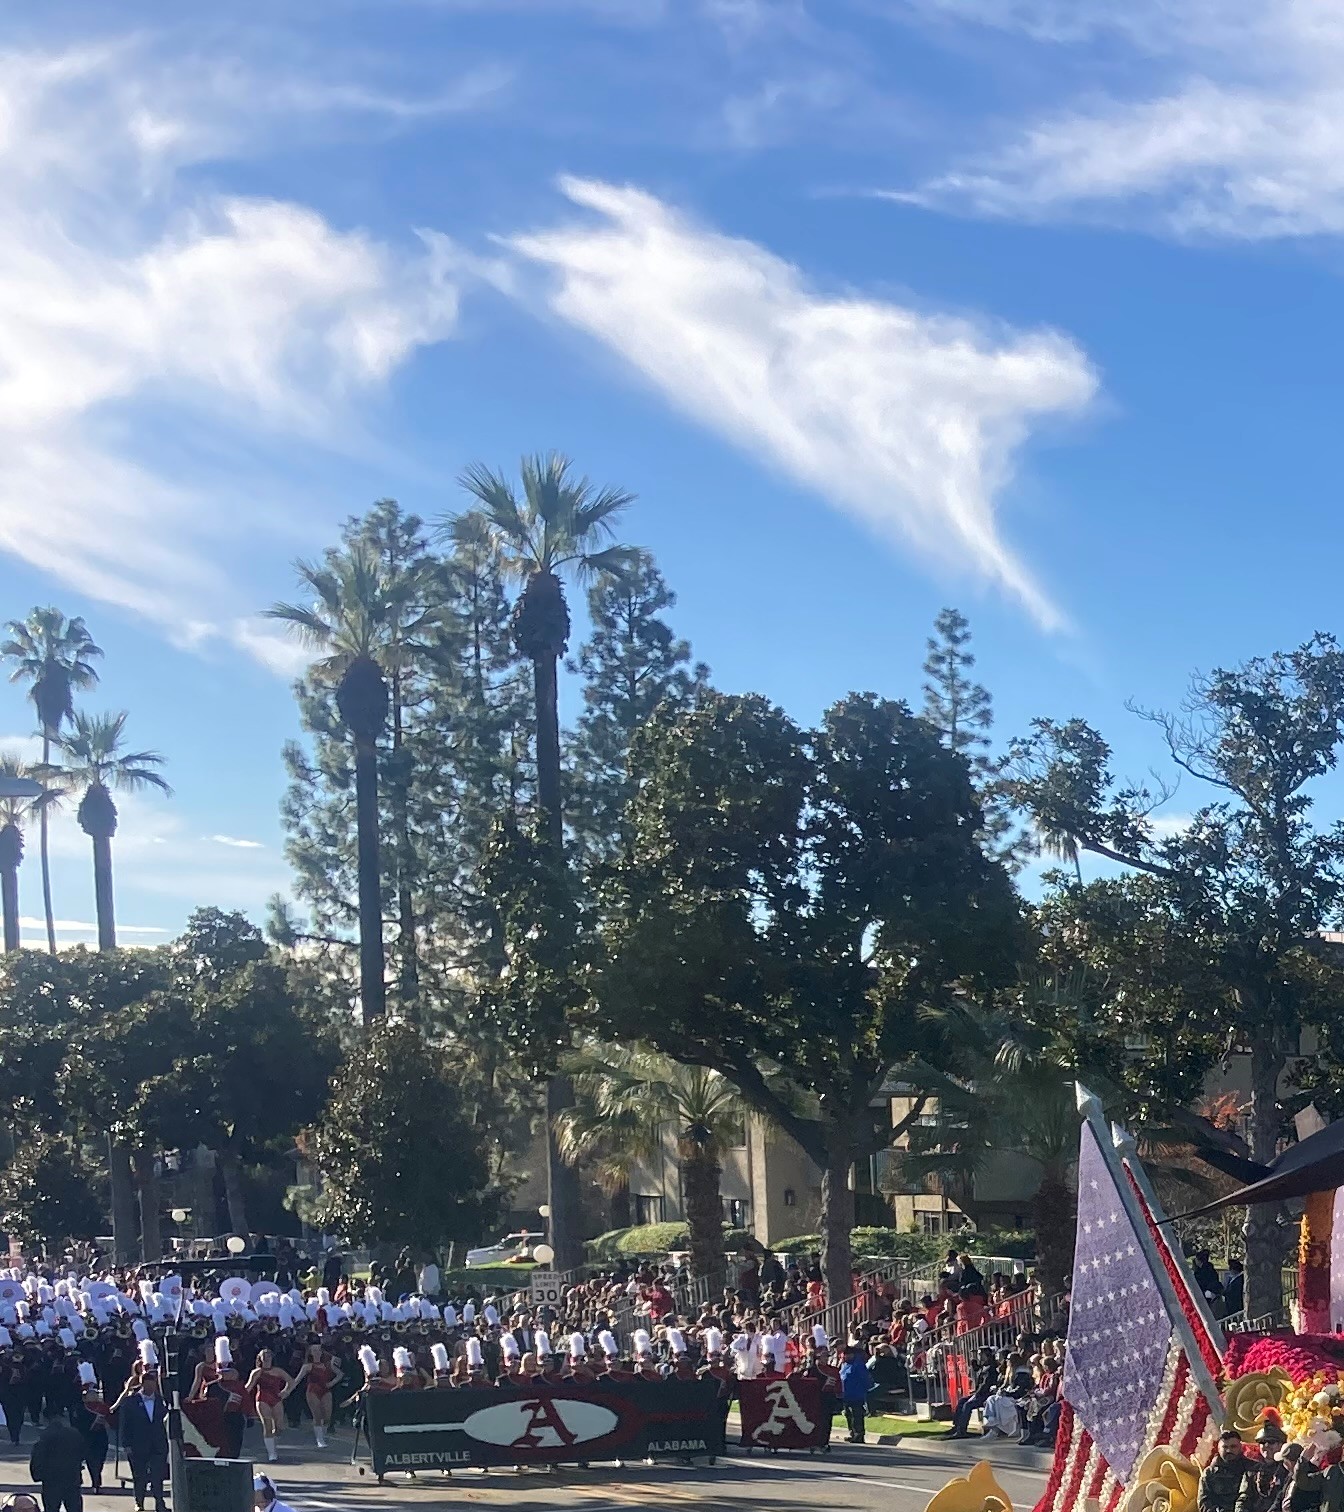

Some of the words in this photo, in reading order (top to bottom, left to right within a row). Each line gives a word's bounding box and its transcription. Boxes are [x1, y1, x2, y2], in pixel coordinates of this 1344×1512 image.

[536, 1290, 557, 1302] 30
[752, 1380, 816, 1446] A
[510, 1399, 578, 1448] A
[647, 1439, 707, 1452] ALABAMA
[385, 1451, 471, 1465] ALBERTVILLE
